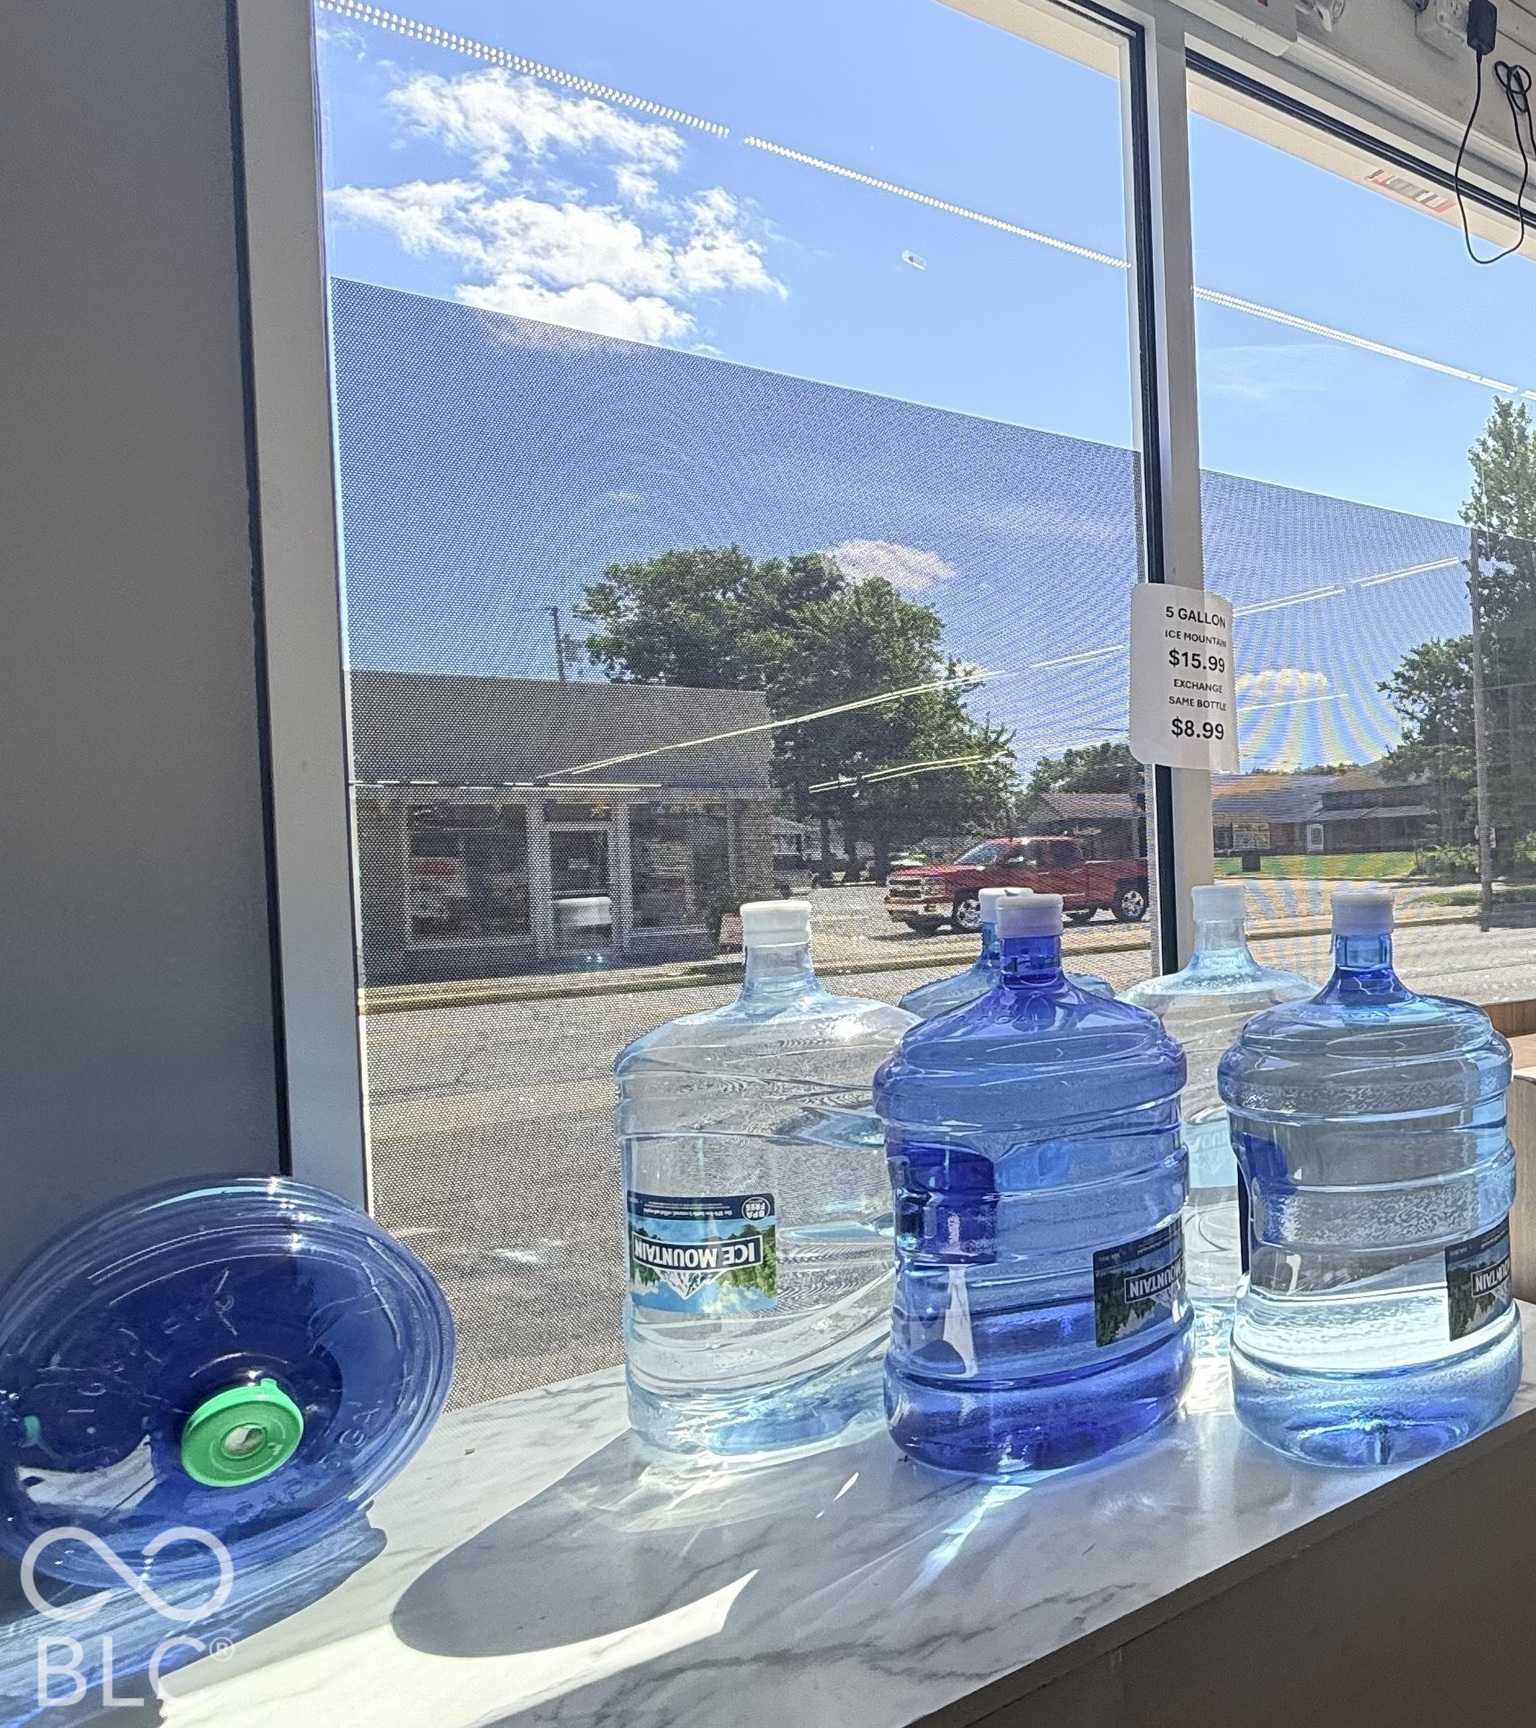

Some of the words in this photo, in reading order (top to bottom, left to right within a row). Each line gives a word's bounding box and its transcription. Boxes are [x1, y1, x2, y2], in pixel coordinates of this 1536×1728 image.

[1165, 606, 1174, 618] 5
[1178, 608, 1226, 629] GALLON
[1165, 629, 1182, 640] ICE
[1183, 632, 1227, 648] MOUNTAIN
[1168, 648, 1225, 674] $15.99
[1173, 679, 1223, 693] EXCHANGE
[1168, 696, 1195, 707] SAME
[1197, 698, 1227, 712] BOTTLE
[1171, 716, 1224, 740] $8.99
[634, 1238, 718, 1268] MOUNTAIN
[722, 1242, 755, 1265] ICE
[1130, 1259, 1181, 1297] MOUNTAIN
[1475, 1258, 1510, 1292] OUNTAIN
